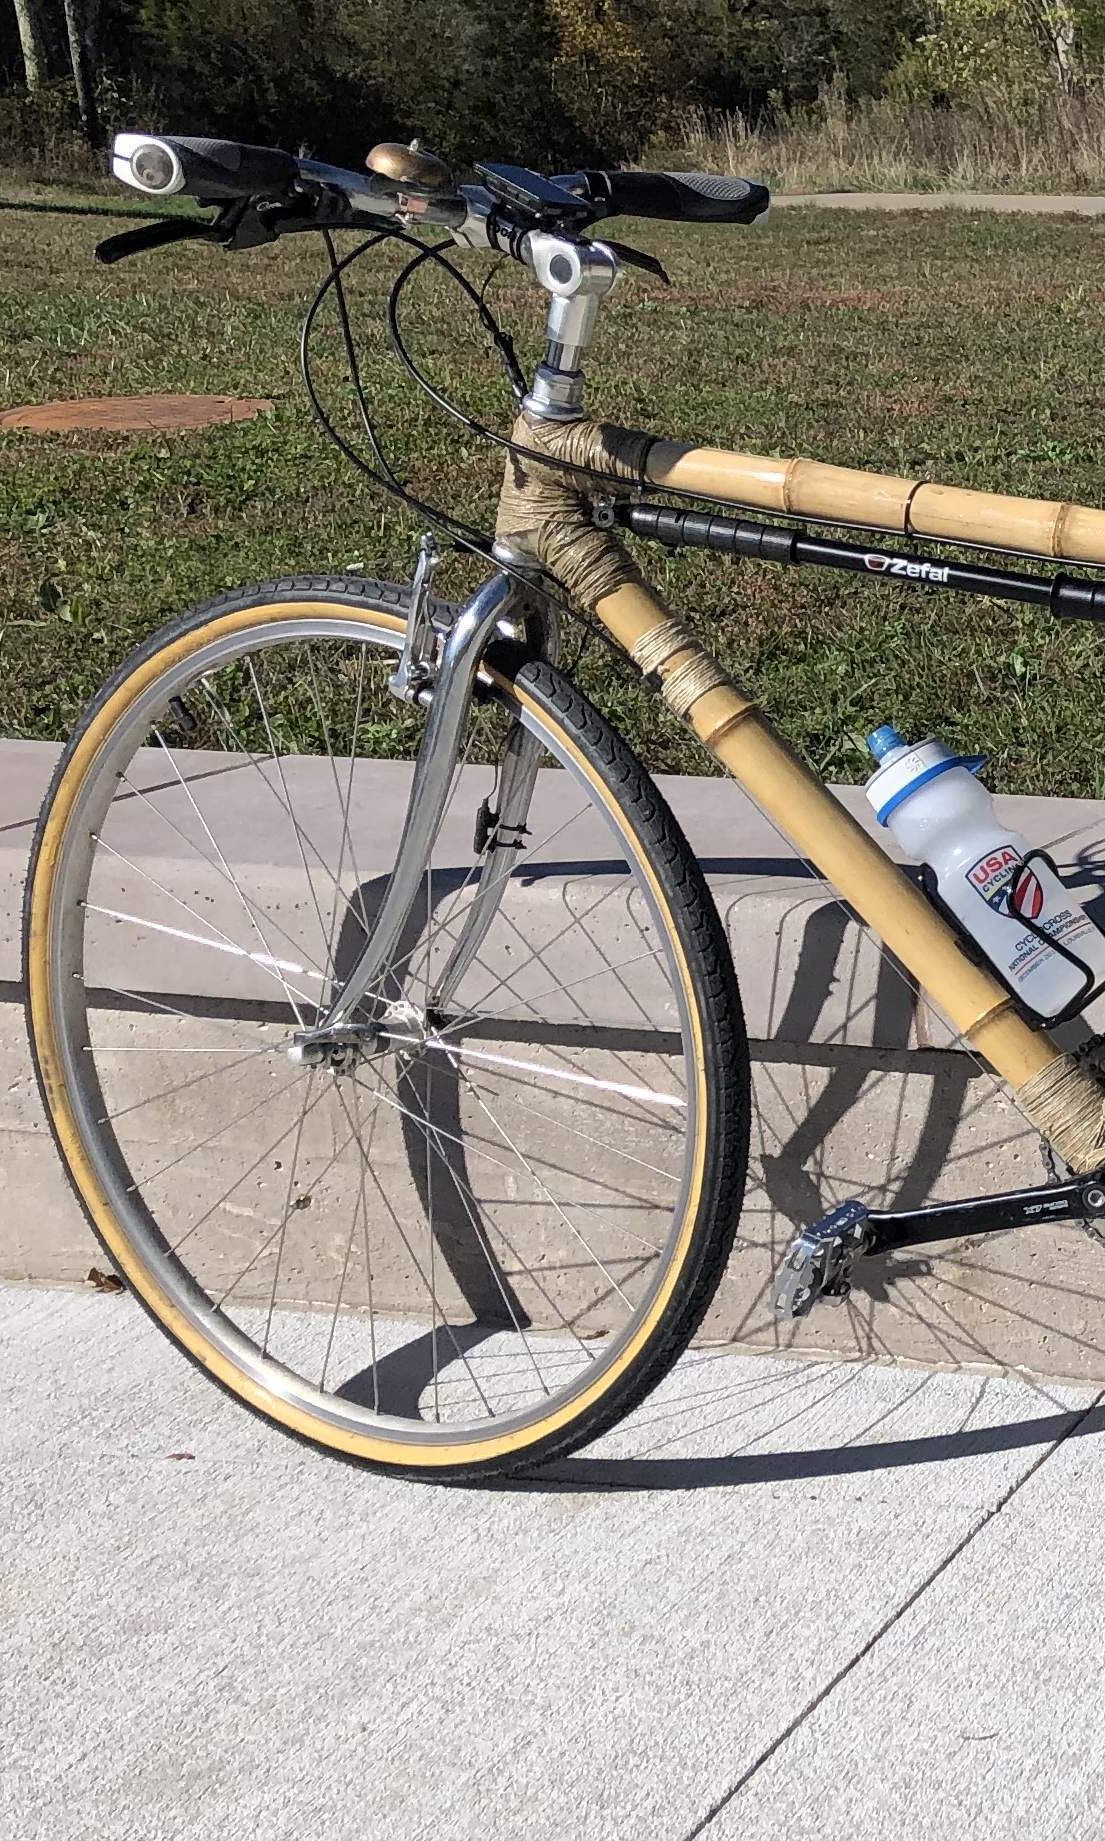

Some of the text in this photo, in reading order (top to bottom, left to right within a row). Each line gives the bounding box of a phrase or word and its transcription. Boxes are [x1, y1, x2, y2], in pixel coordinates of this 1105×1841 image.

[973, 851, 1018, 884] USA
[983, 864, 1018, 892] CYCLIN
[1015, 910, 1072, 951] CYCLCROSS
[1008, 945, 1039, 972] NATIONAL
